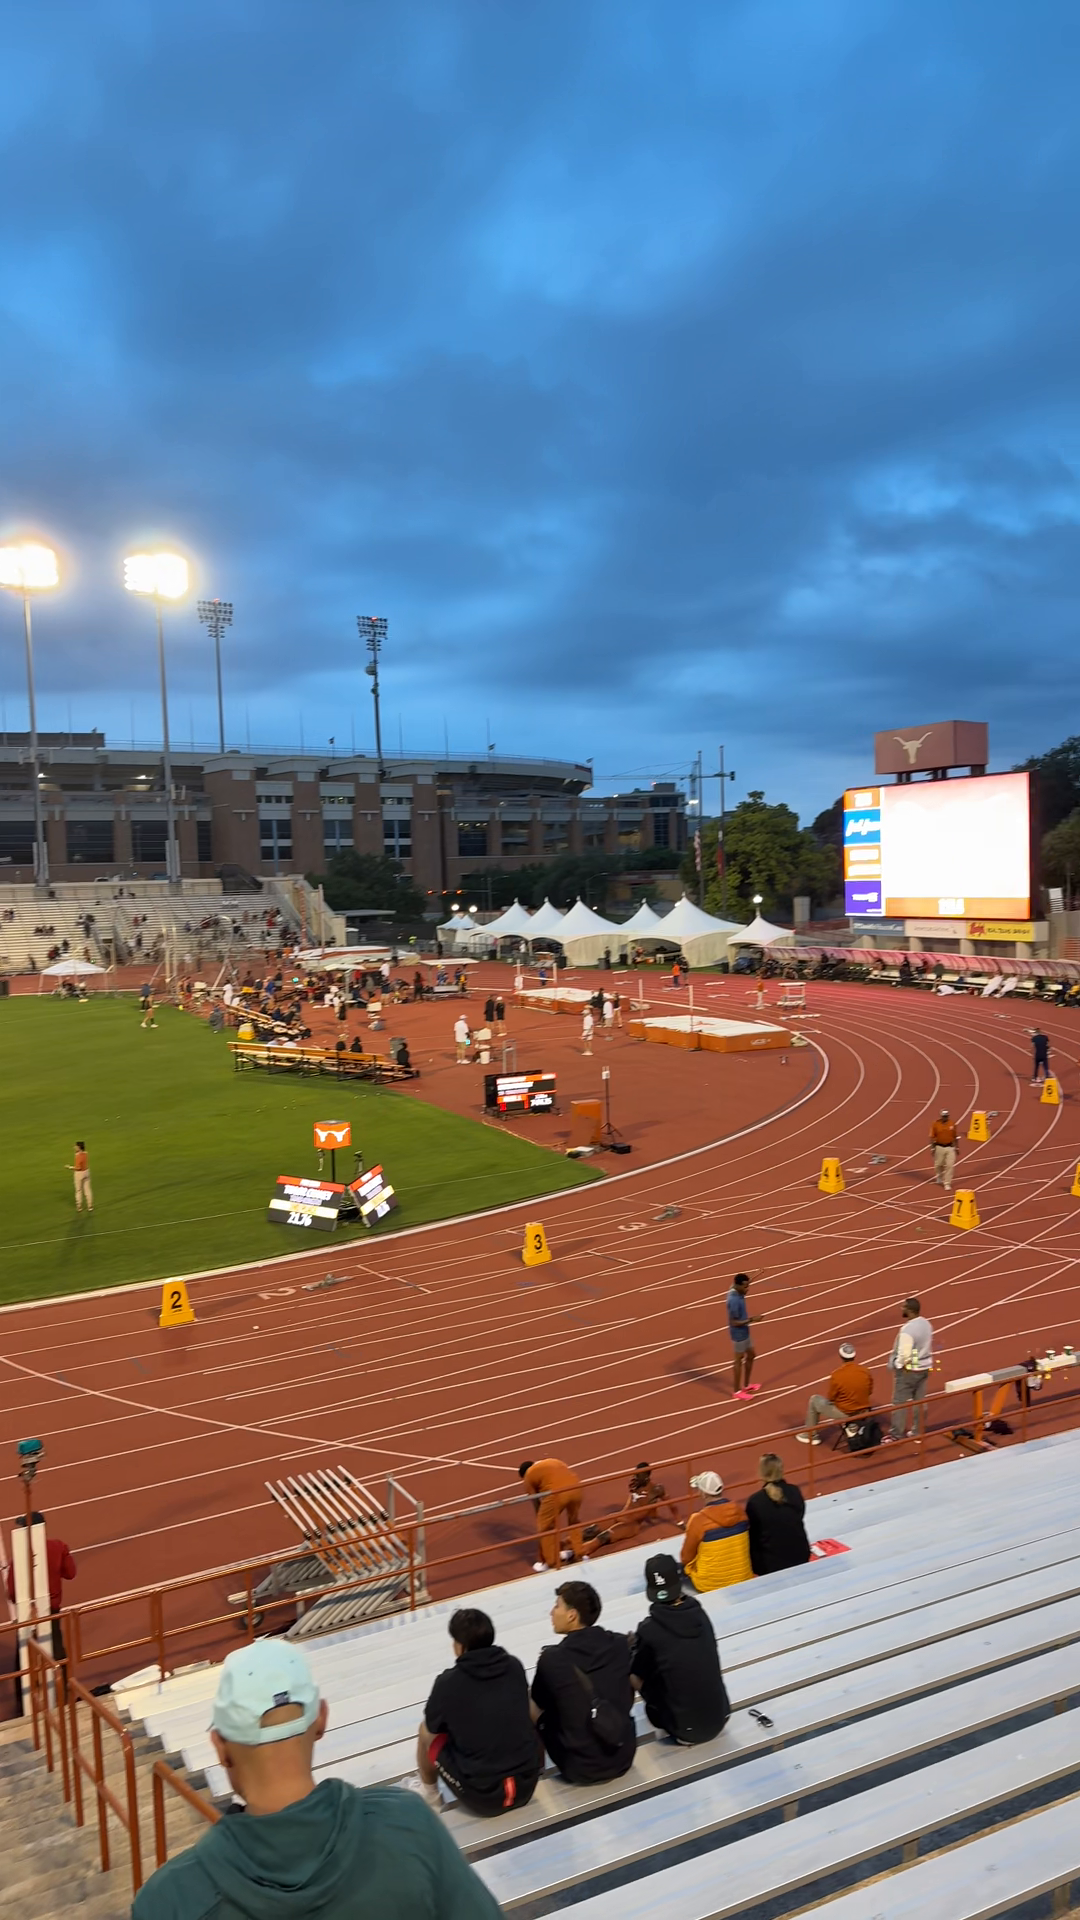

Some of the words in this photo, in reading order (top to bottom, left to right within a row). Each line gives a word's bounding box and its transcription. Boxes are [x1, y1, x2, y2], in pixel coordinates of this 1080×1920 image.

[1047, 1084, 1053, 1095] 6
[974, 1118, 980, 1130] 5
[956, 1199, 963, 1214] 7
[533, 1233, 543, 1250] 3
[170, 1290, 182, 1310] 2
[256, 1286, 297, 1301] 2
